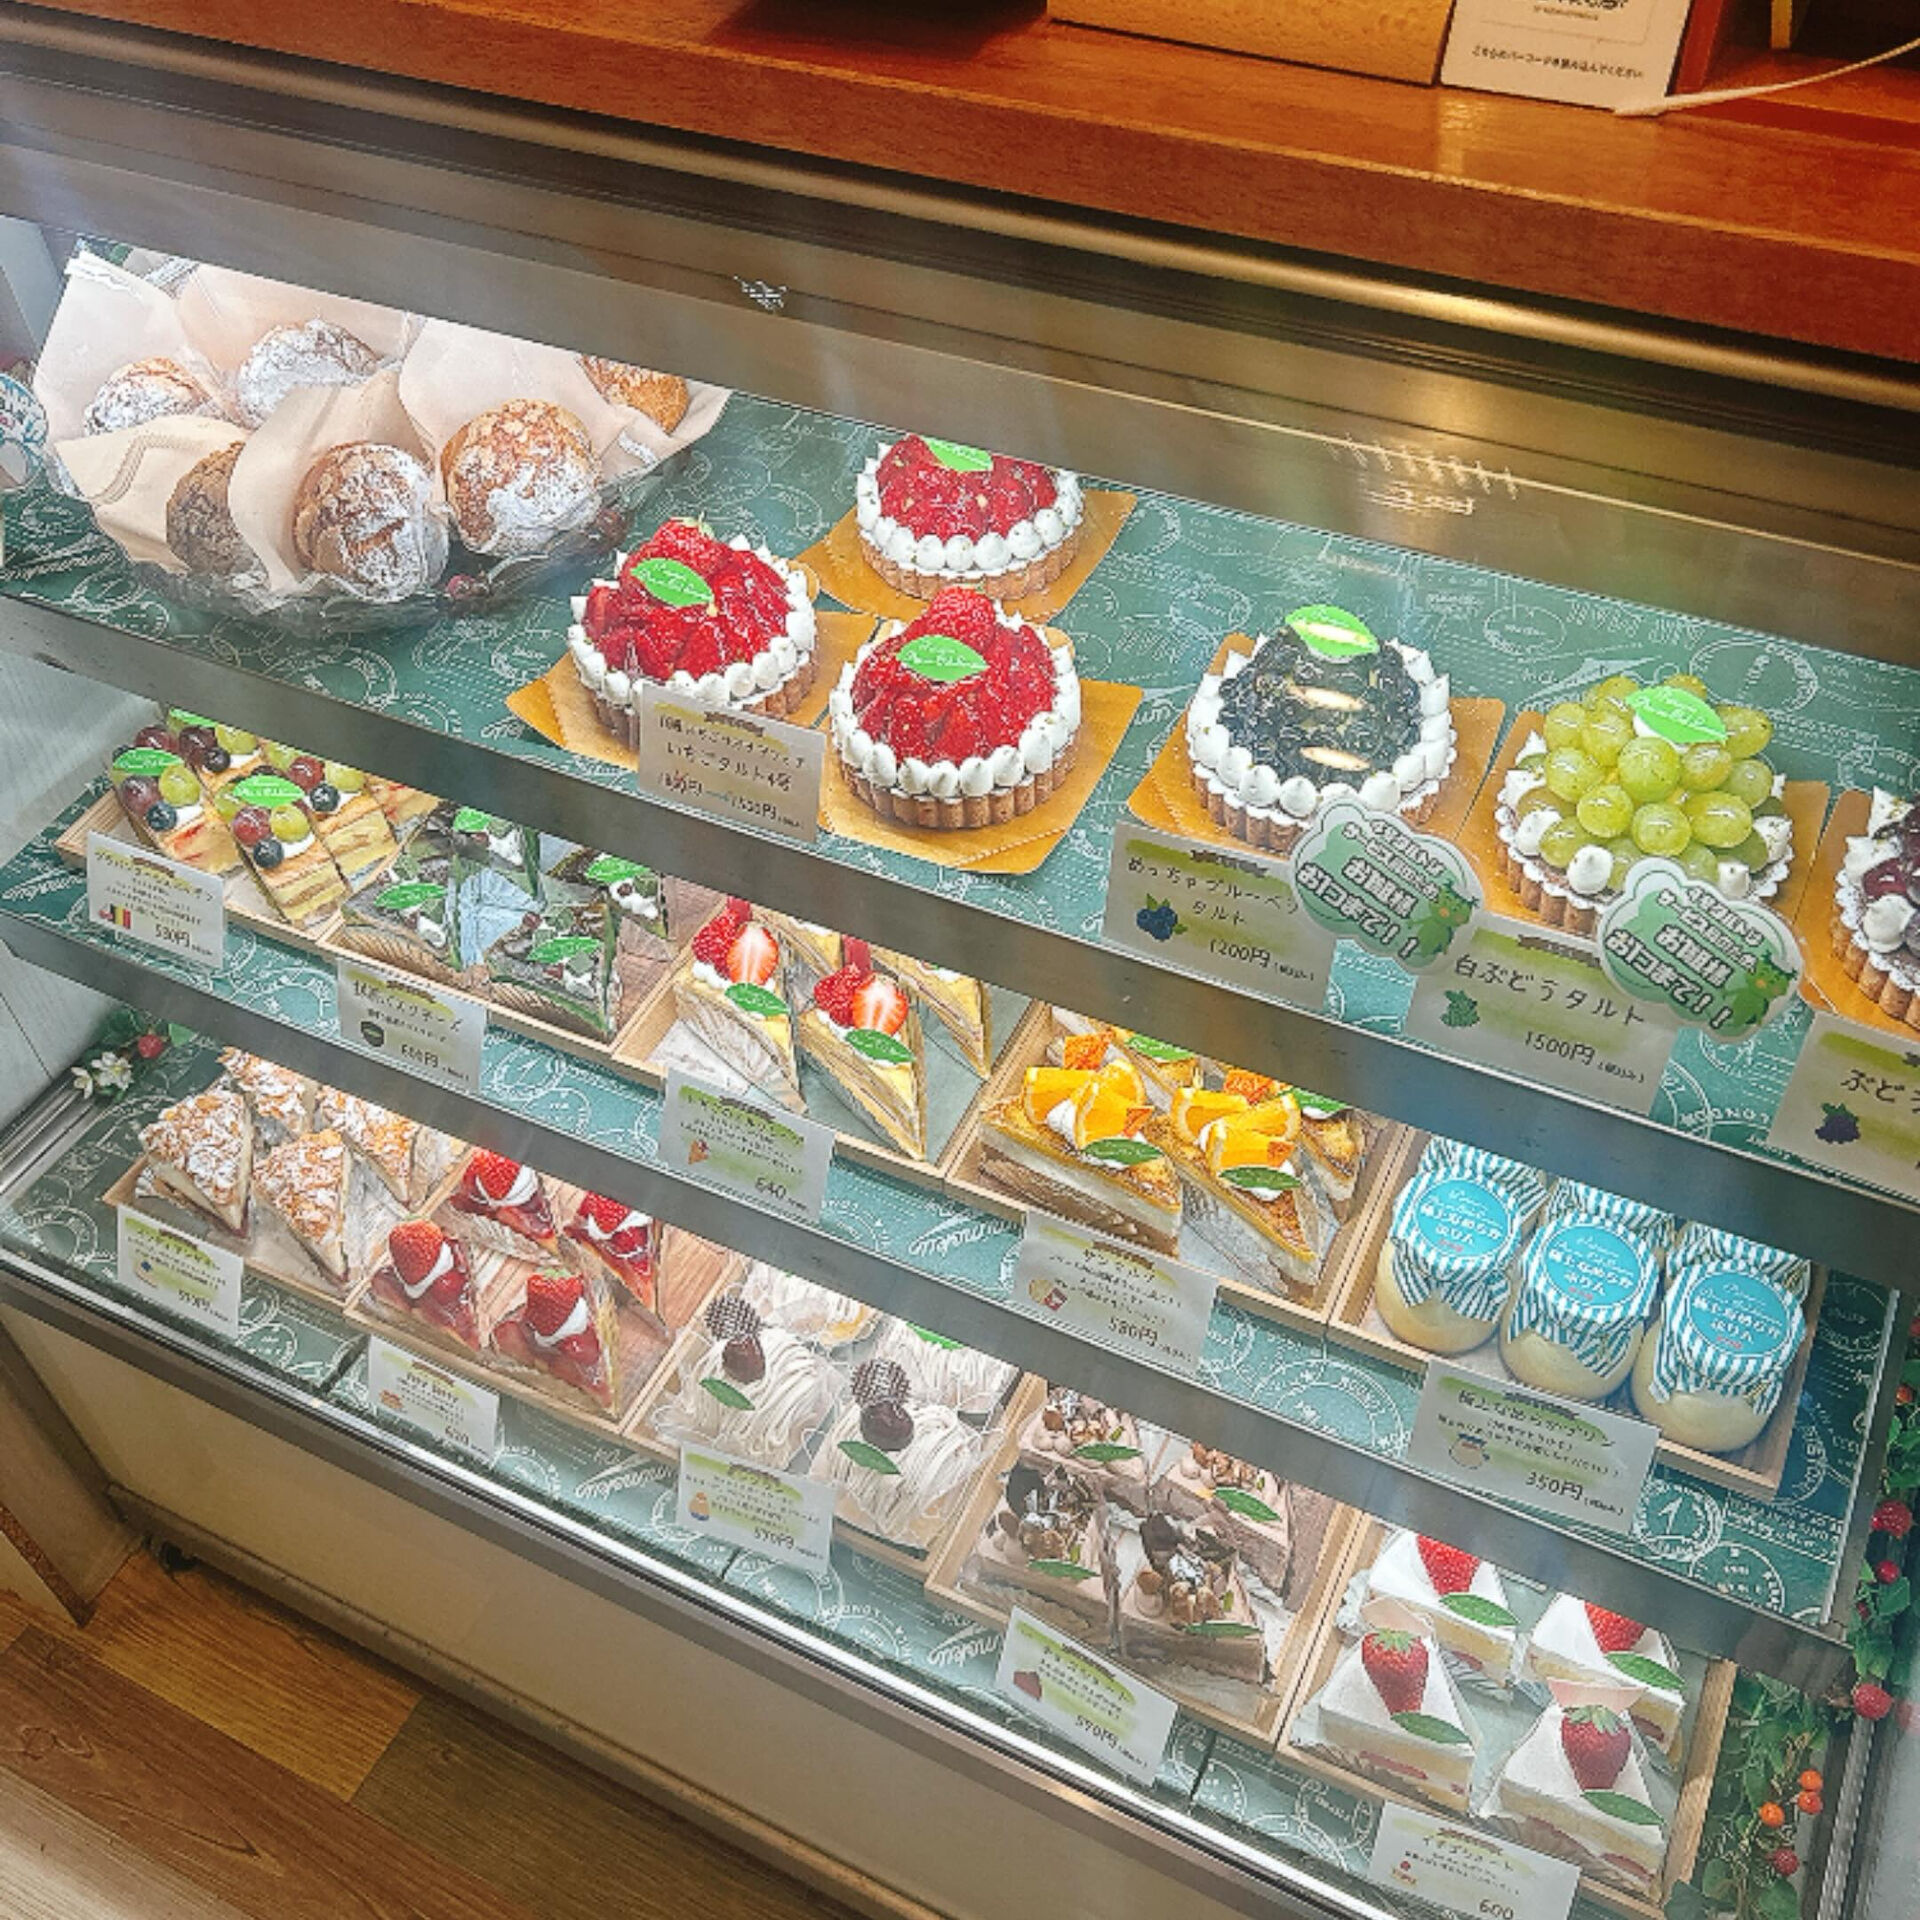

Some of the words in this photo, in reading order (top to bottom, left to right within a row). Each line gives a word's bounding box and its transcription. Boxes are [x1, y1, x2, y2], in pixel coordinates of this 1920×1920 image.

[1192, 902, 1246, 926] タルト
[1210, 938, 1270, 968] 1200円
[1454, 953, 1646, 1026] 白ぶどうタルト
[1524, 1030, 1596, 1067] 1500円
[1525, 1471, 1583, 1501] 350円
